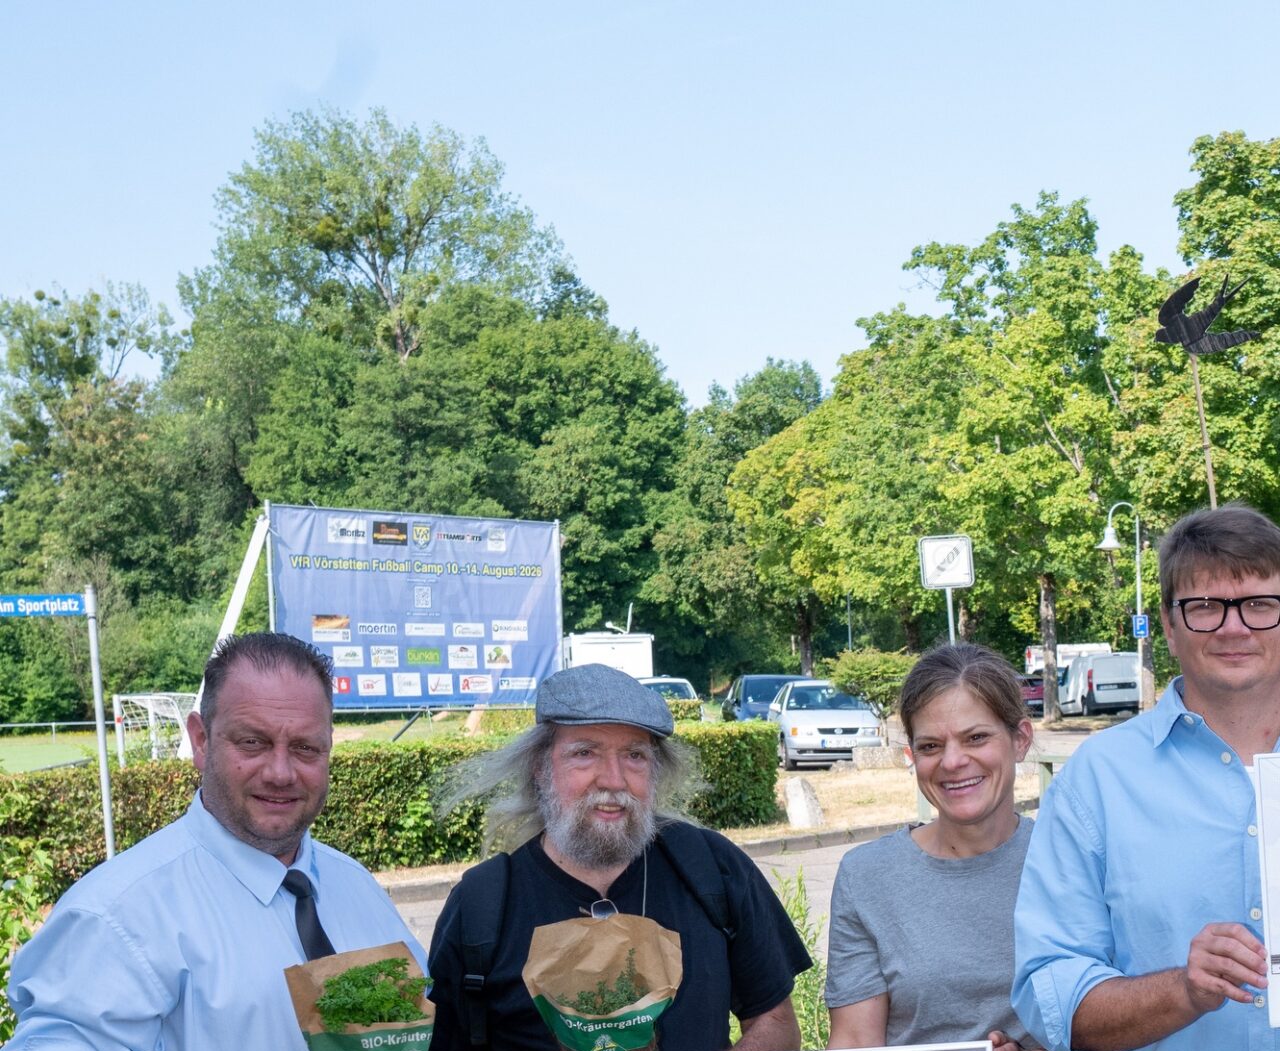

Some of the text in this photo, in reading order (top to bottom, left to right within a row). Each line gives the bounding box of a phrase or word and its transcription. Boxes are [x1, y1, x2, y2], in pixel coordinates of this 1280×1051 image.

[290, 555, 310, 569] VfR
[314, 556, 370, 571] Vörstetten
[372, 559, 412, 572] Fußball
[413, 561, 444, 576] Camp
[483, 565, 517, 579] August
[519, 566, 542, 577] 2026
[17, 598, 79, 615] Sportplatz
[359, 624, 396, 633] maertin
[562, 1014, 653, 1032] O-Kräutergarten
